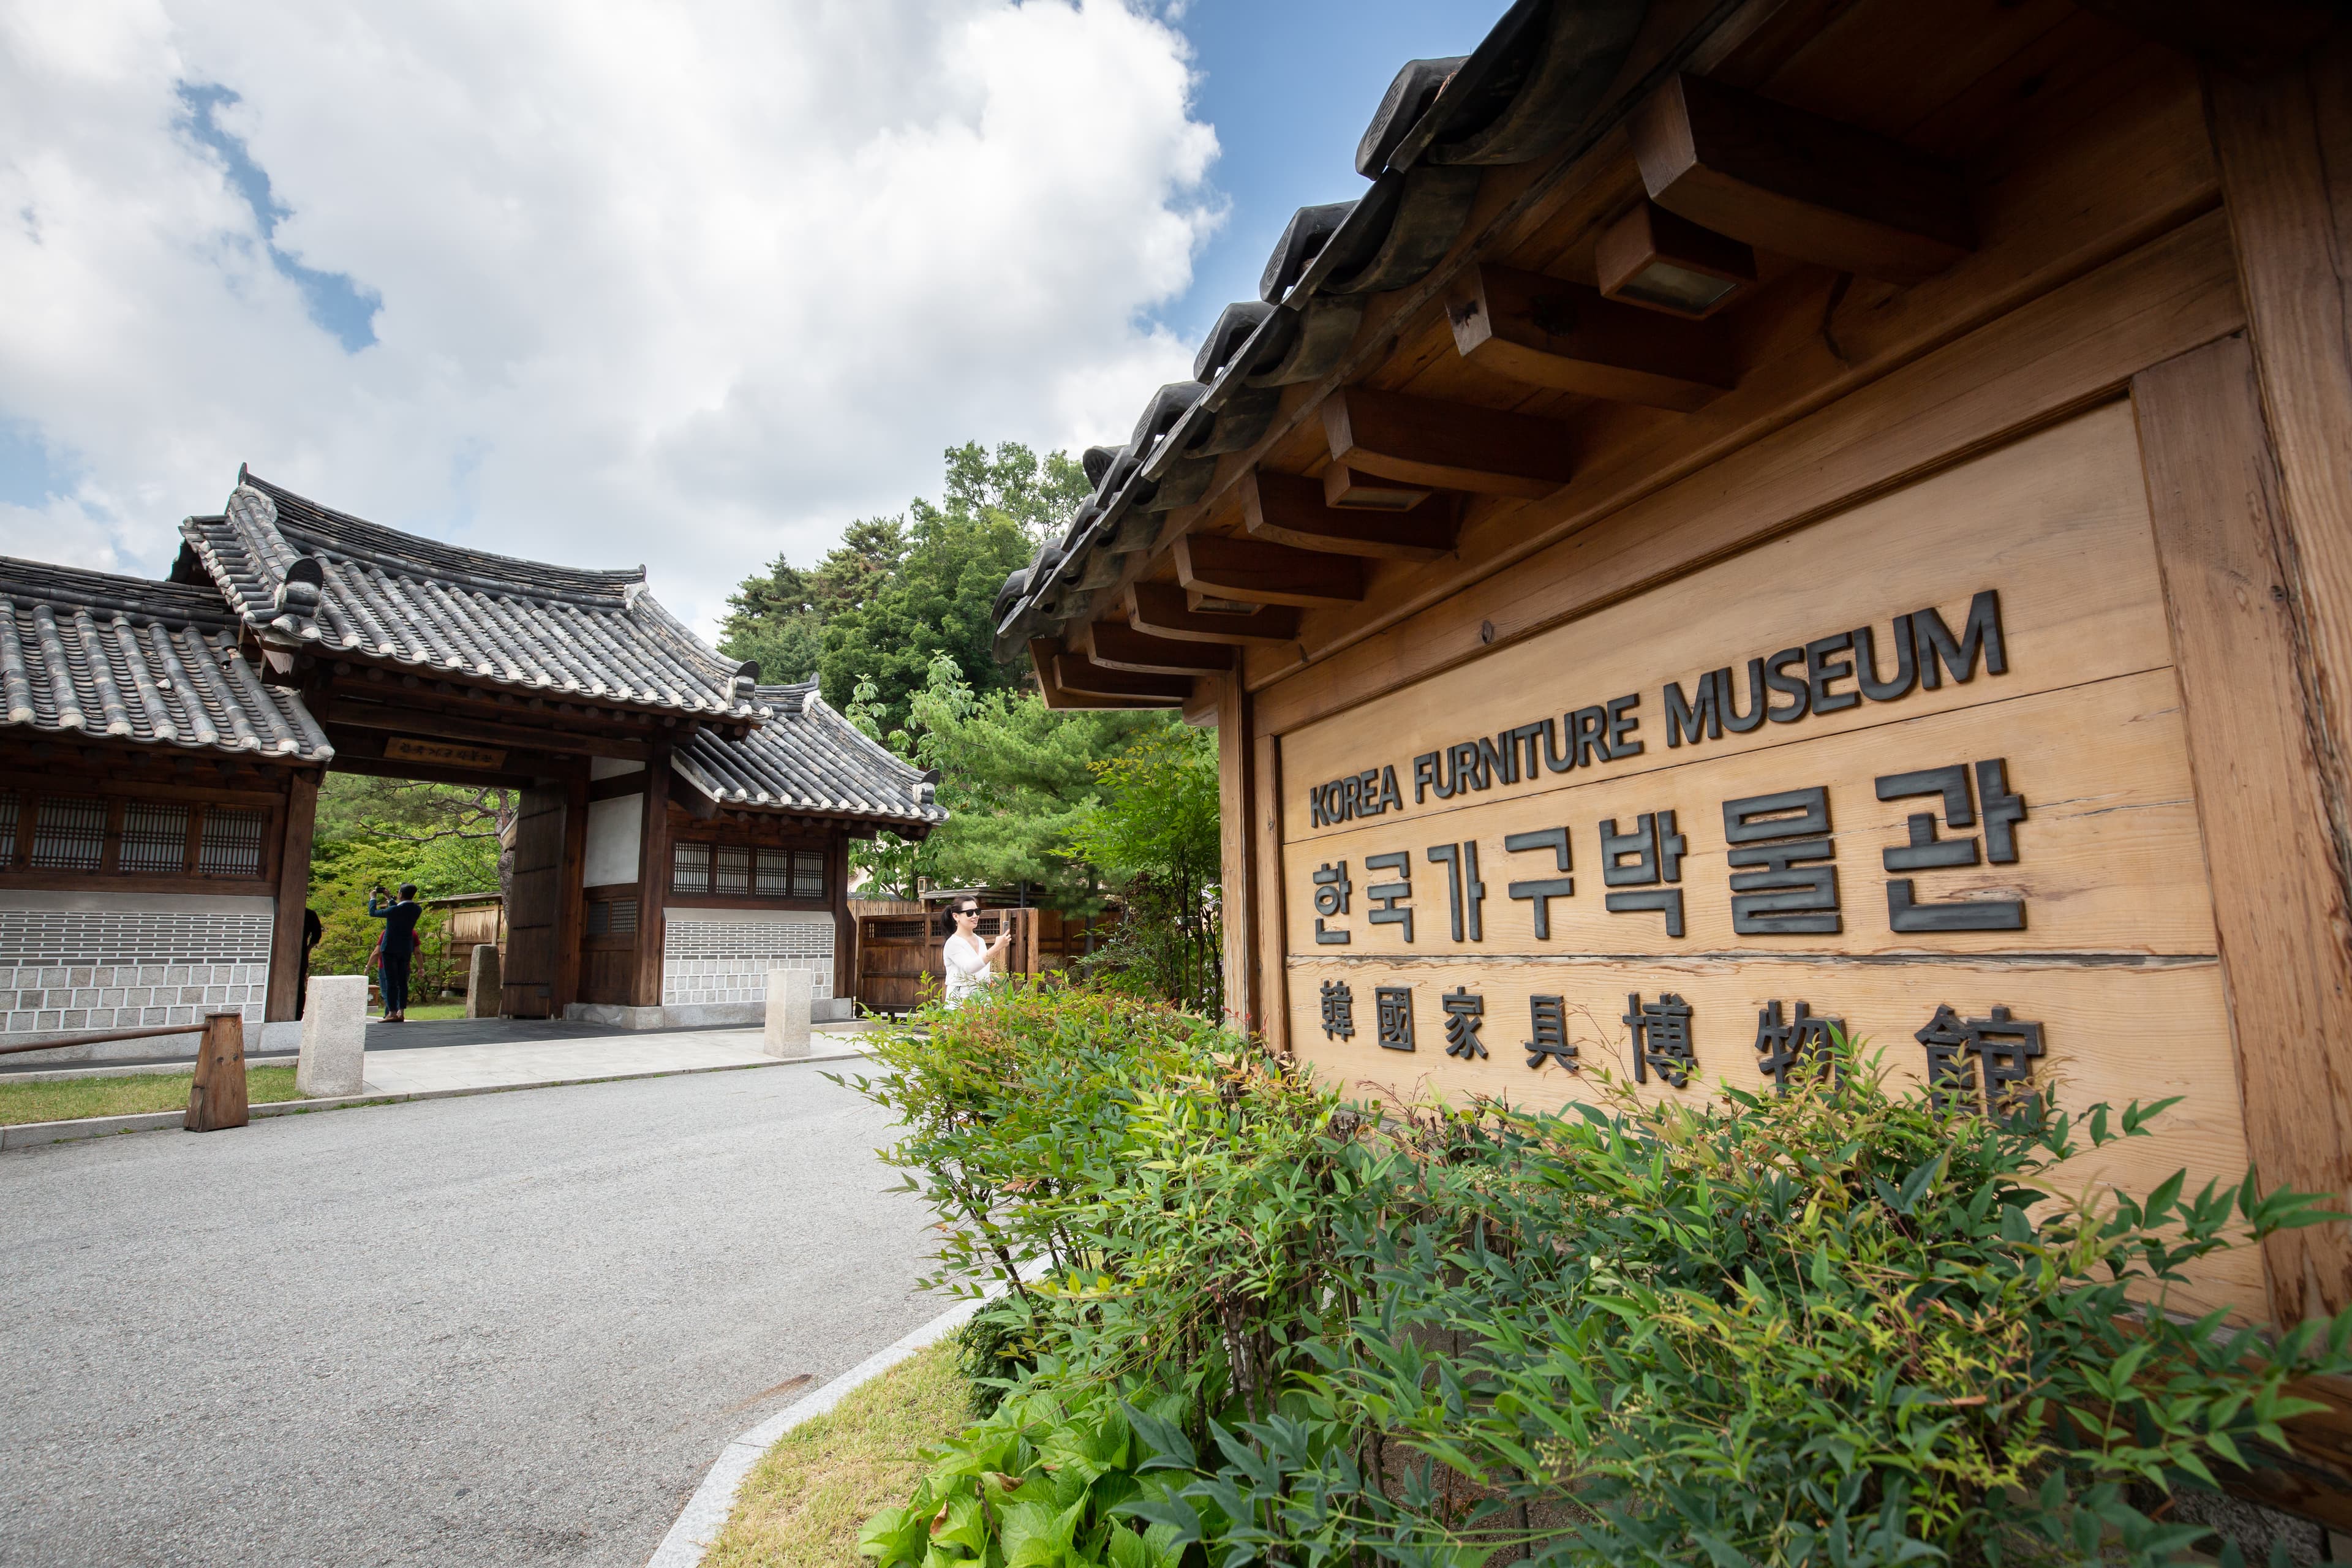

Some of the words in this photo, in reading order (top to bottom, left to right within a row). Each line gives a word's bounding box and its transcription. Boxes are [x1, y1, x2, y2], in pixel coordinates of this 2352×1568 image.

[1310, 764, 1403, 829] KOREA
[1414, 693, 1645, 804] FURNITURE
[1663, 589, 2008, 748] MUSEUM
[1313, 758, 2028, 945] 한국가구박물관
[1320, 980, 2047, 1130] 韓國家具博物館
